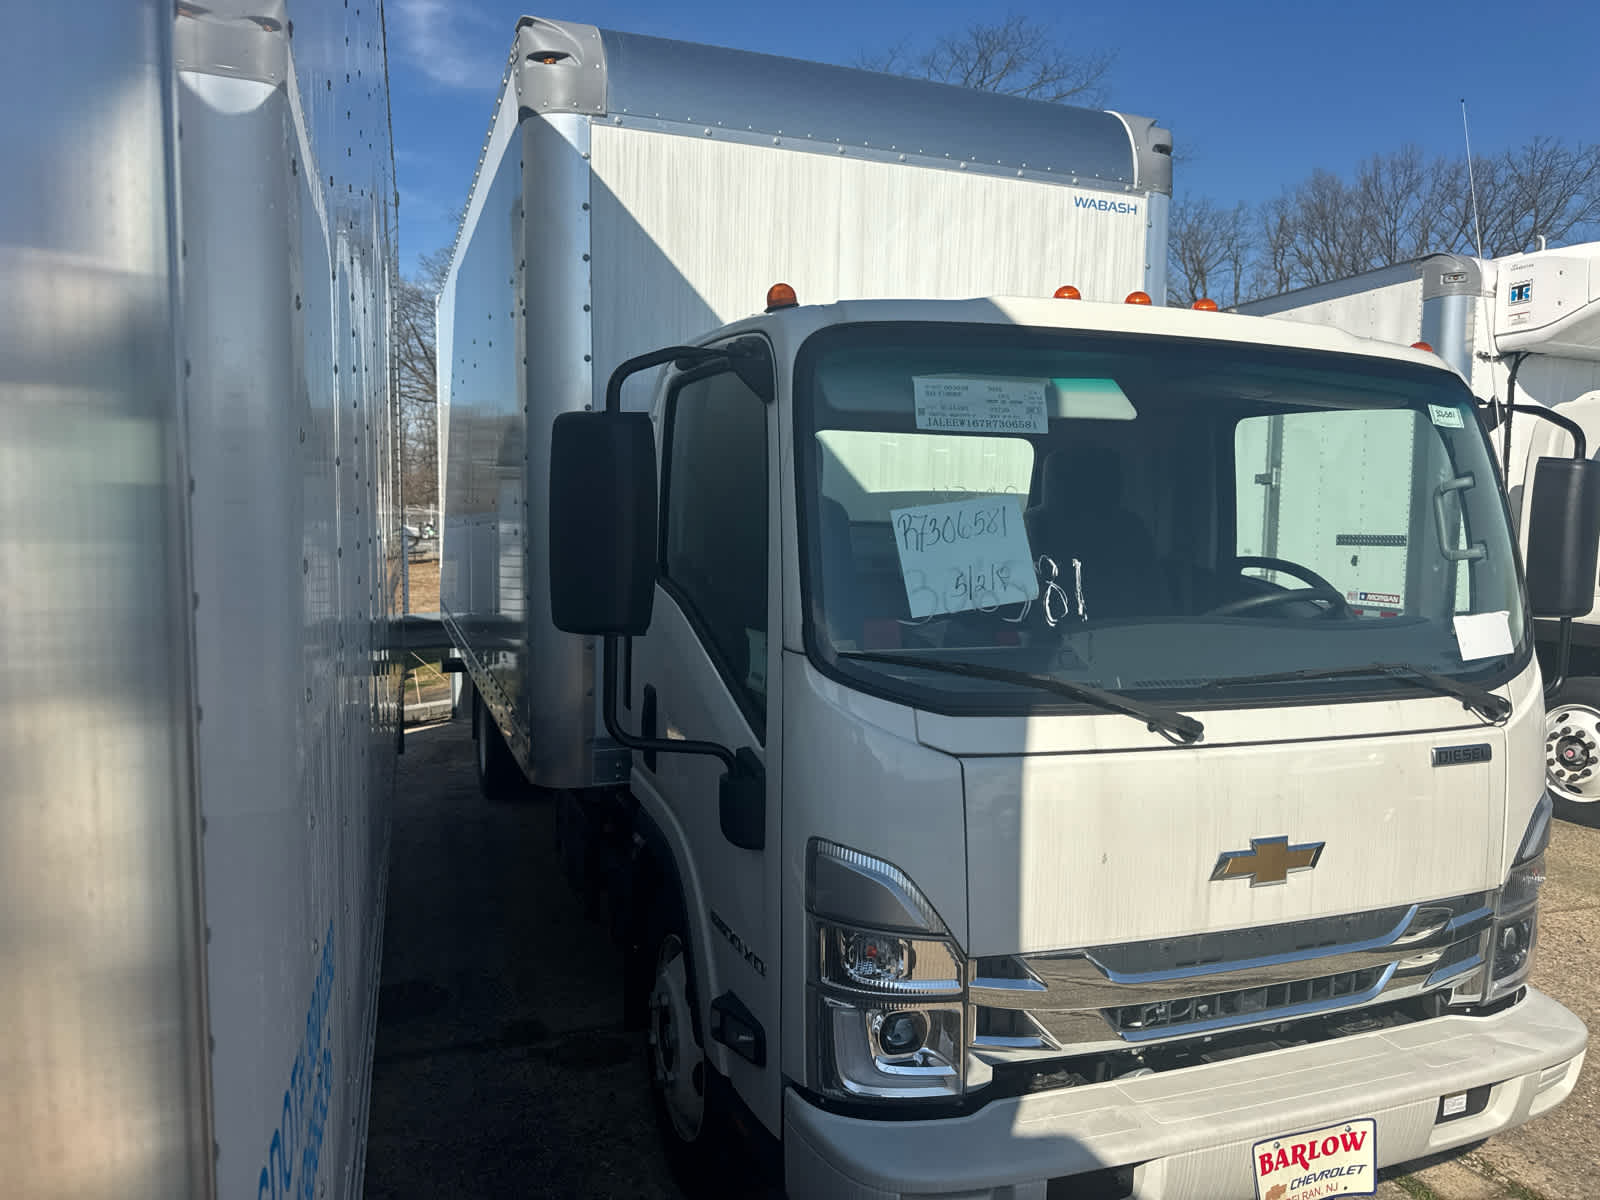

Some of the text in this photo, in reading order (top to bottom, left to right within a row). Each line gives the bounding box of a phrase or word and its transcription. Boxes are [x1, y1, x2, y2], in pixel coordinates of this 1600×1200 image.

[1074, 196, 1137, 215] WABASH
[897, 506, 1008, 552] R7306581
[1436, 747, 1487, 764] DIESEL
[1259, 1131, 1367, 1176] BARLOW
[1290, 1164, 1368, 1190] CHEVROLET
[1326, 1182, 1339, 1194] NJ
